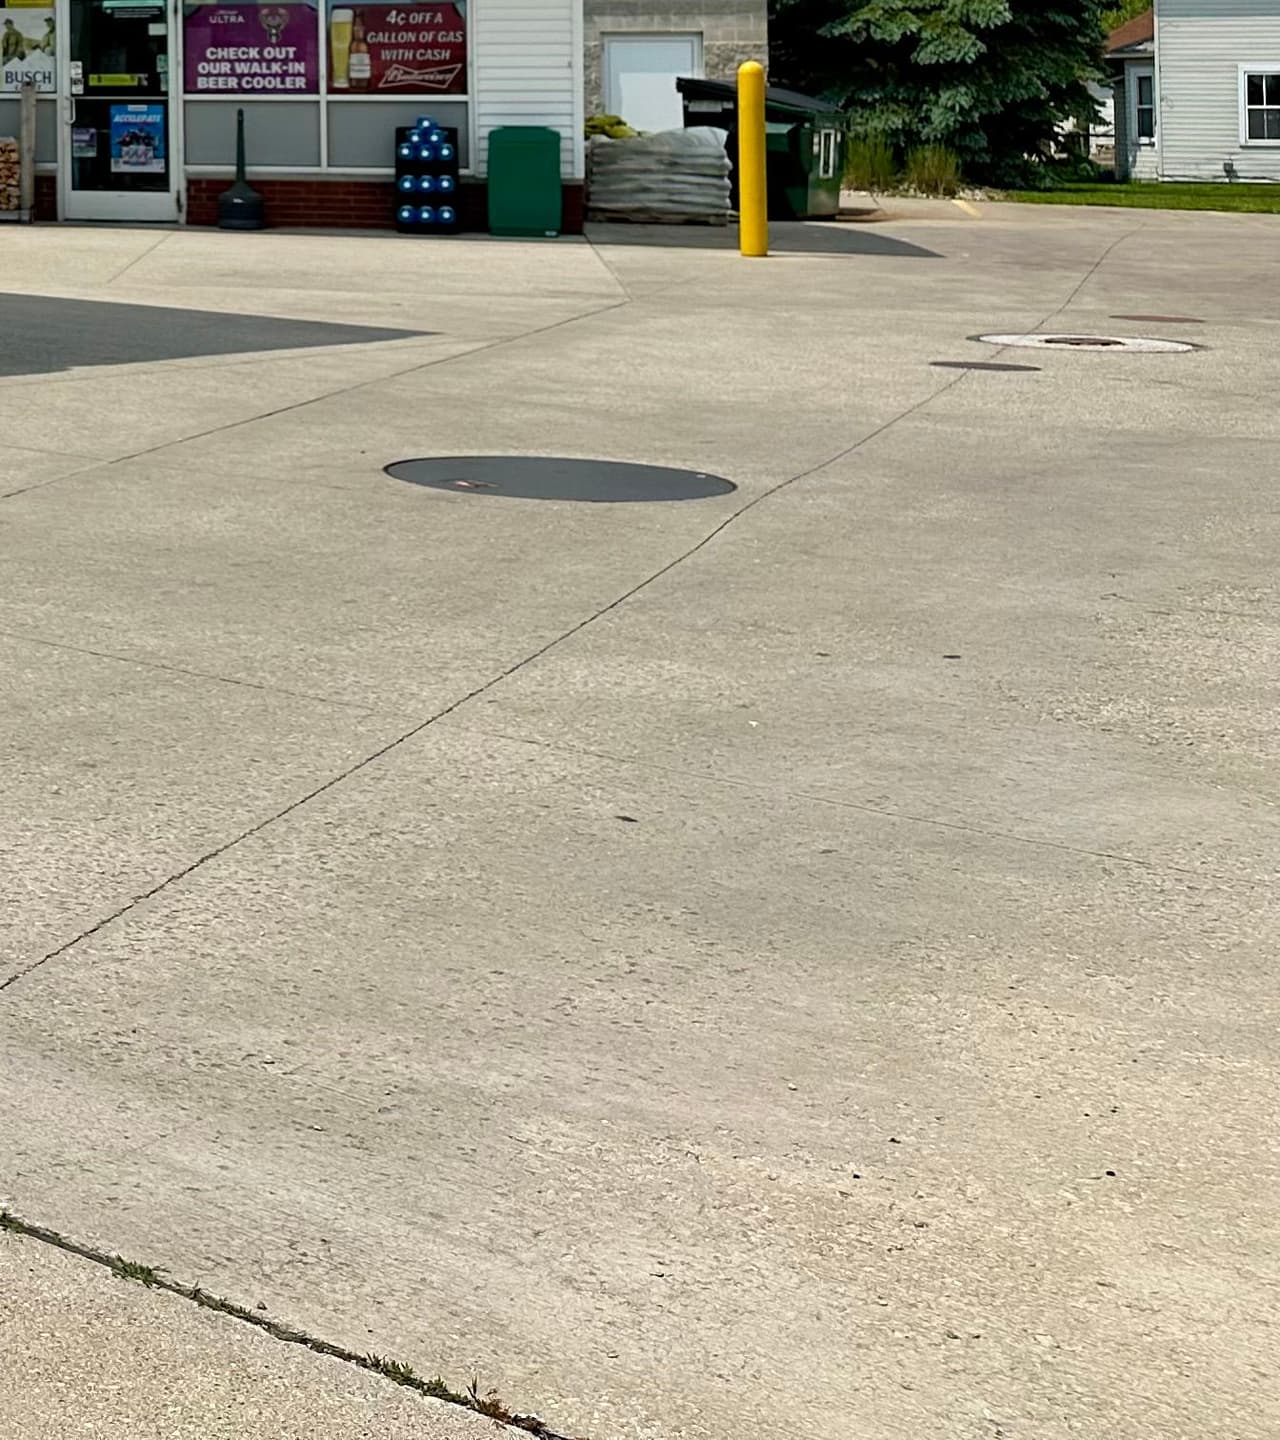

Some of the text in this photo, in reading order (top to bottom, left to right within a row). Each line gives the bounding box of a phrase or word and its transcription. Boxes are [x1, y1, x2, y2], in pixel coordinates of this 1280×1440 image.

[209, 15, 245, 24] ULTRA
[386, 11, 444, 26] 4¢ OFF A
[366, 31, 464, 44] GALLON OF GAS
[206, 47, 297, 60] CHECK OUT
[381, 49, 452, 61] WITH CASH
[197, 62, 306, 75] OUR WALK-IN
[4, 71, 53, 85] BUSCH
[386, 68, 453, 83] Budweiser
[196, 76, 307, 89] BEER COOLER
